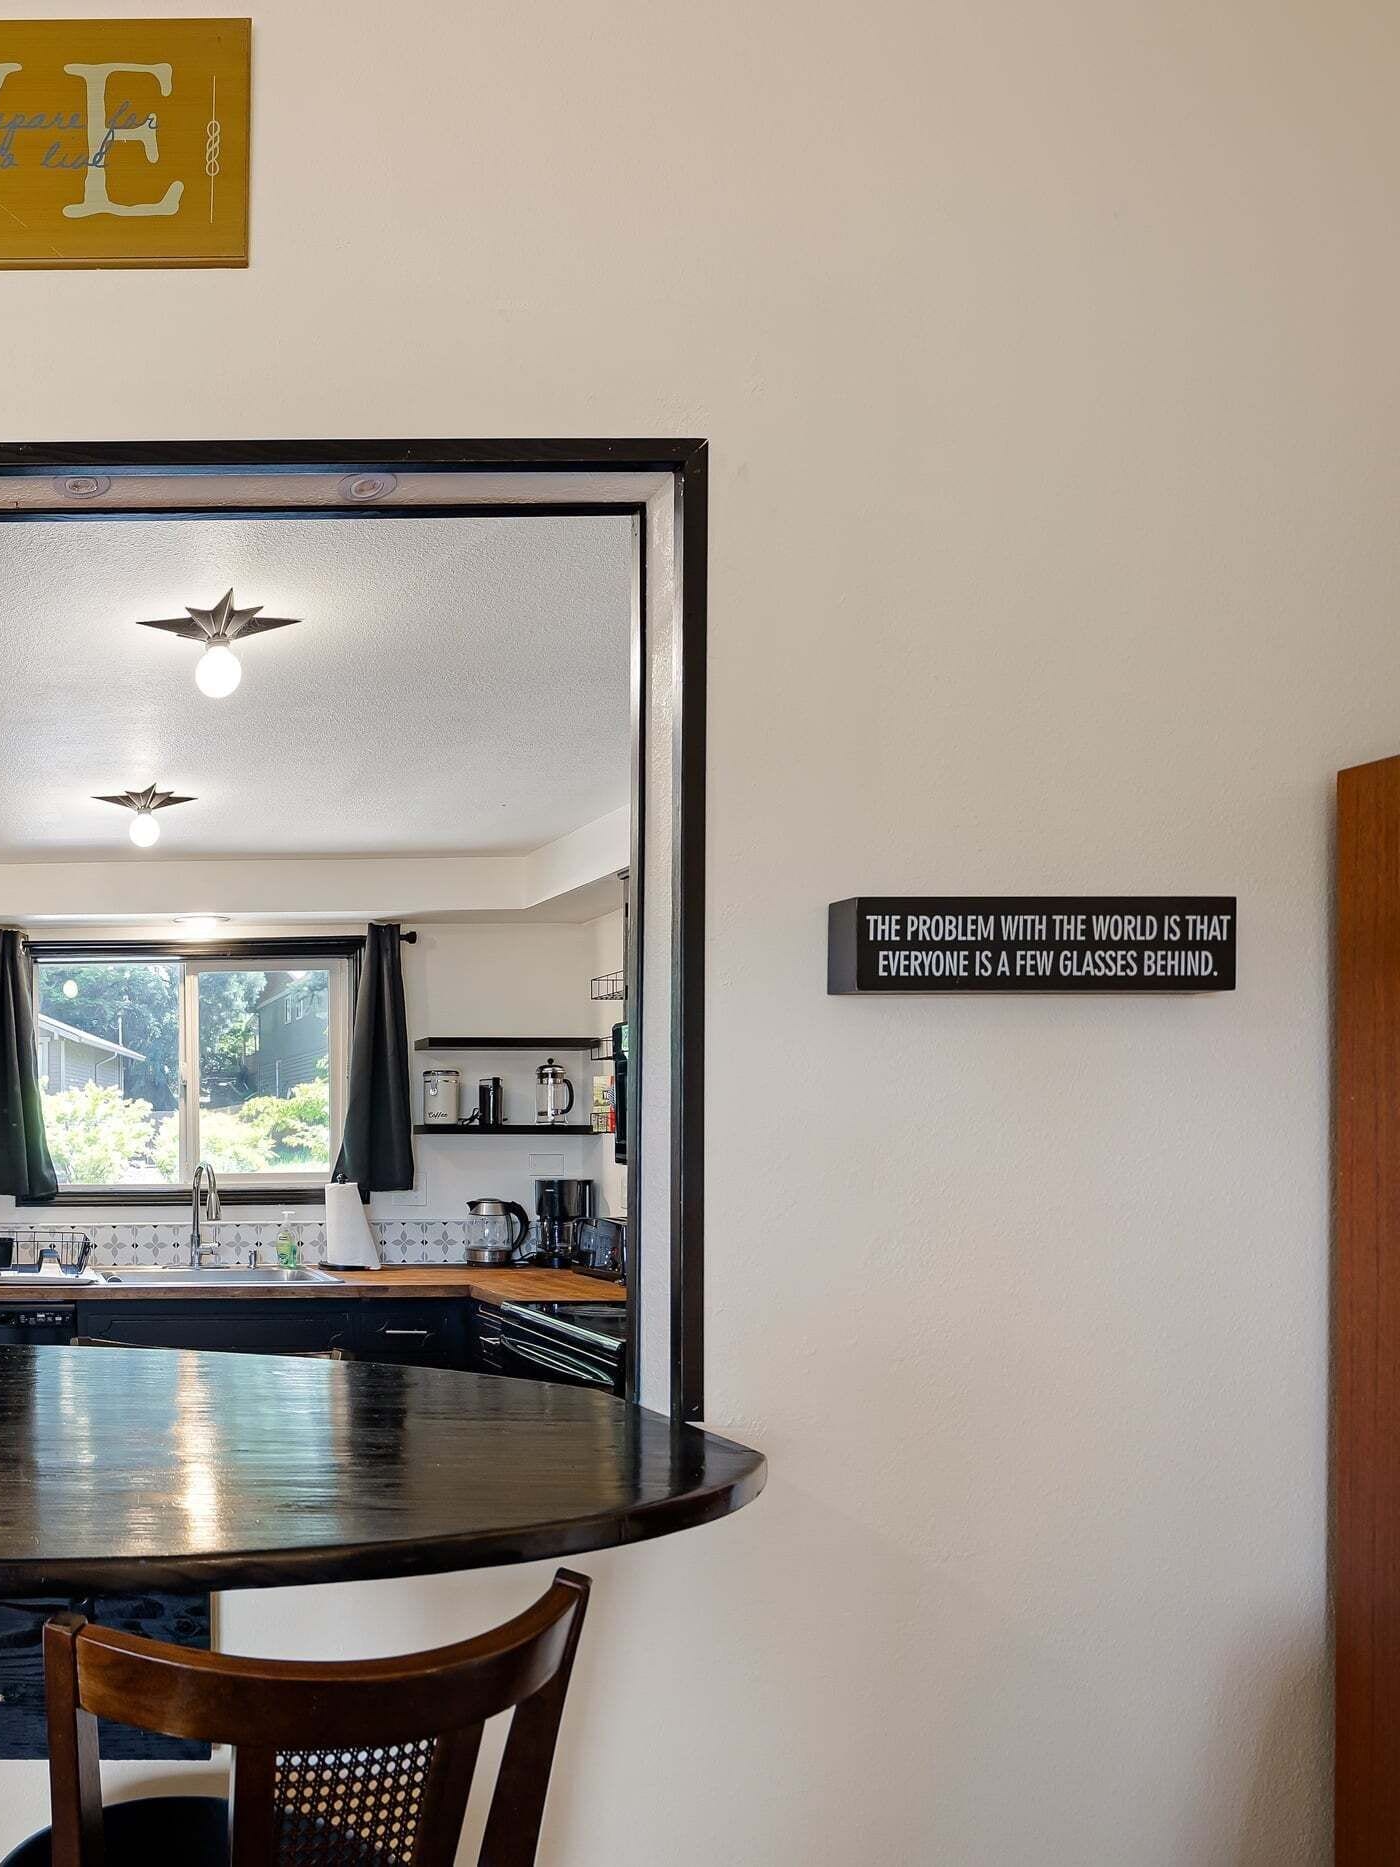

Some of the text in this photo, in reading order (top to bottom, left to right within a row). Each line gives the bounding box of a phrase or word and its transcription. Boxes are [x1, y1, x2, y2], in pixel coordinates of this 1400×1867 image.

[96, 101, 158, 166] for
[40, 141, 109, 169] live
[866, 915, 1231, 941] THE PROBLEM WITH THE WORLD IS THAT
[878, 950, 1218, 977] EVERYONE IS A FEW GLASSES BEHIND.
[427, 1111, 449, 1119] Coffee
